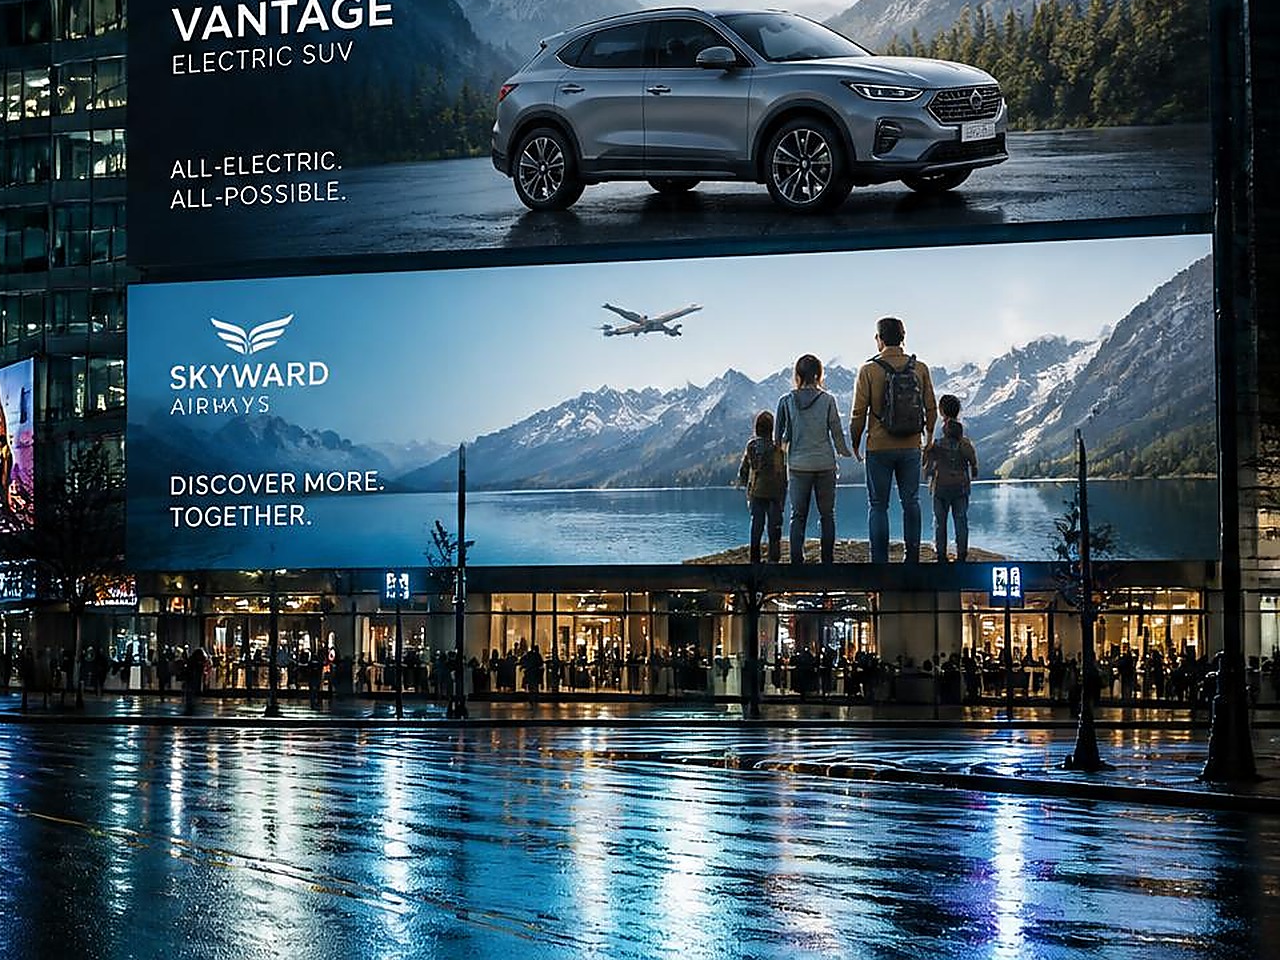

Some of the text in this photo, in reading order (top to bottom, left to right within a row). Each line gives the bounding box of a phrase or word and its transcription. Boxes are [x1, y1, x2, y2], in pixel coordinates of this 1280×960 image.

[172, 40, 353, 75] ELECTRIC SUV
[170, 151, 342, 180] ALL-ELECTRIC.
[170, 180, 346, 210] ALL-POSSIBLE.
[170, 361, 329, 390] SKYWARD
[170, 467, 388, 496] DISCOVER MORE.
[169, 504, 315, 528] TOGETHER.
